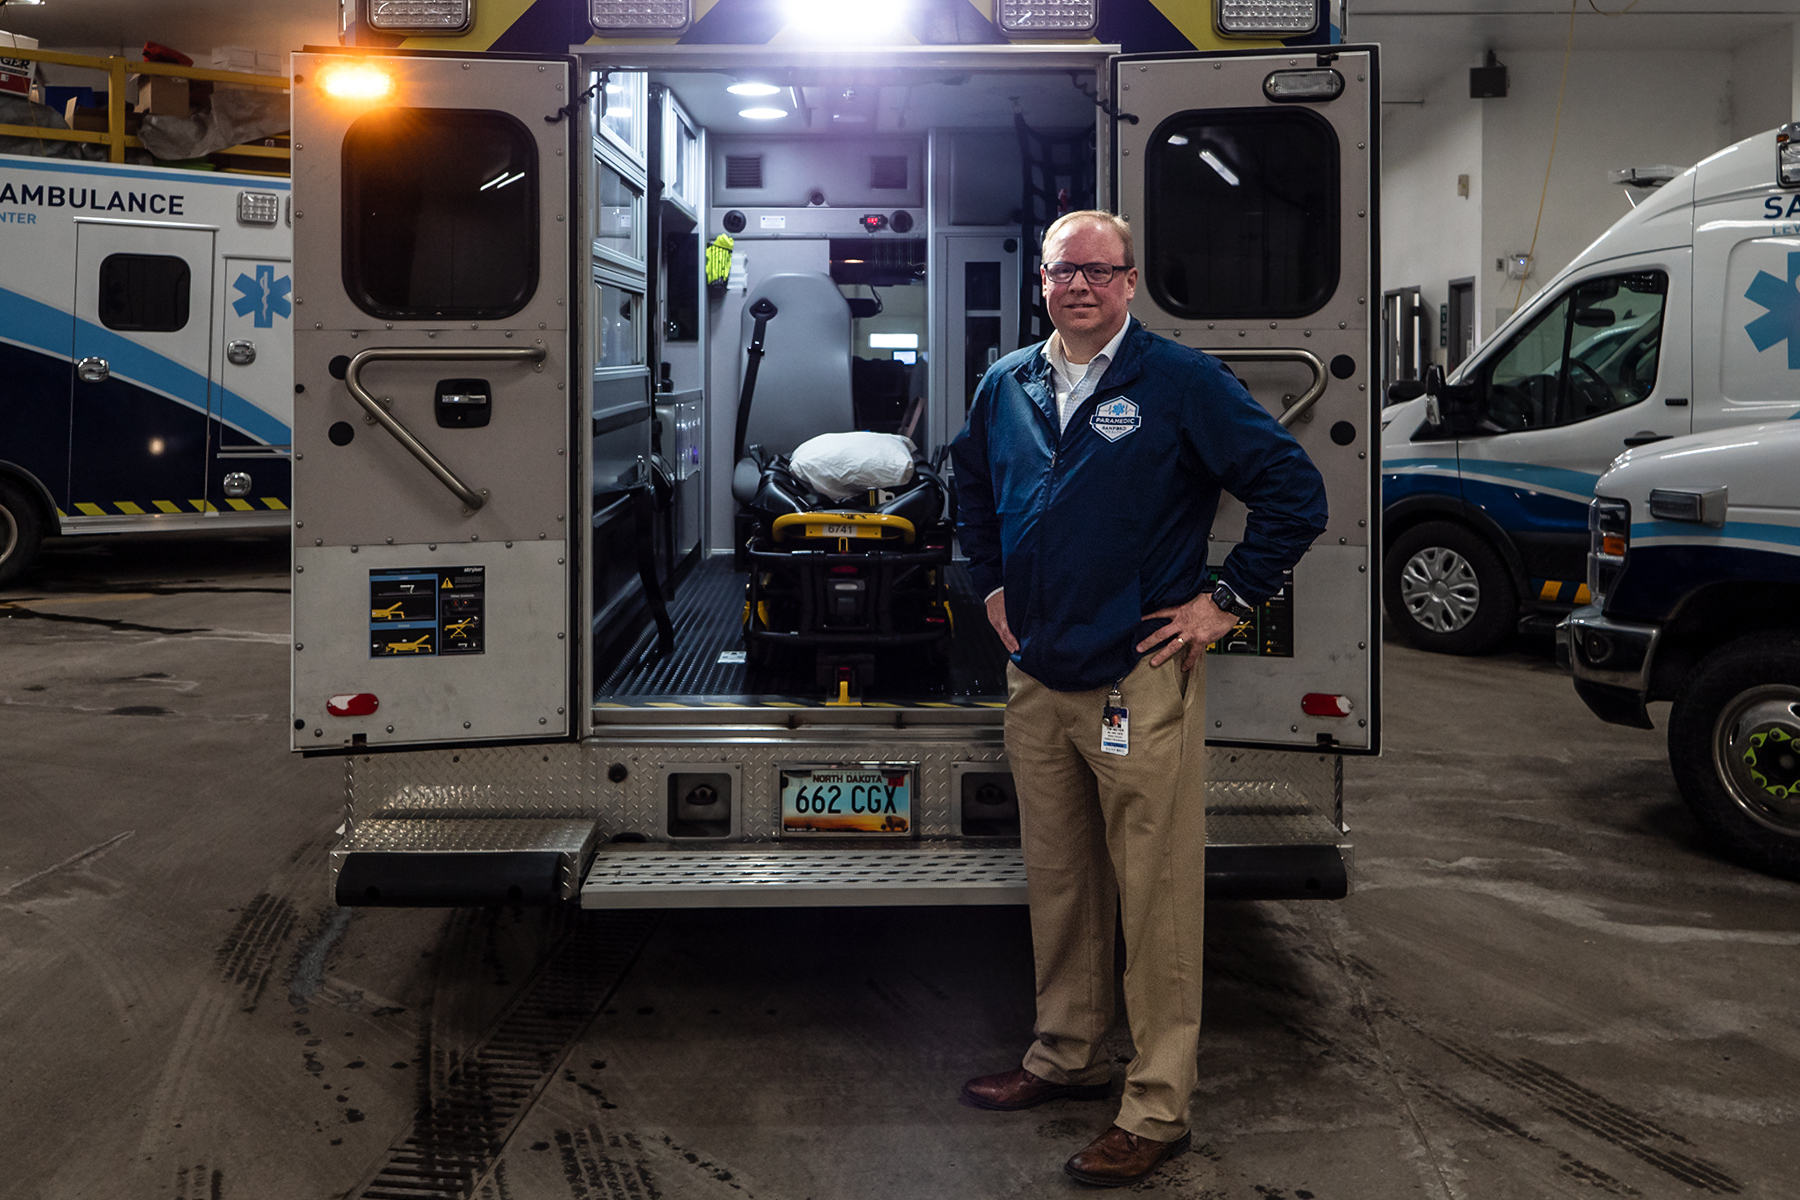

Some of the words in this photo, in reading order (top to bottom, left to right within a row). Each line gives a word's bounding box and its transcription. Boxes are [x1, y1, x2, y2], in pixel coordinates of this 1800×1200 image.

[0, 183, 184, 216] AMBULANCE
[1764, 194, 1800, 219] SA
[828, 524, 853, 534] 6741
[812, 774, 843, 783] NORTH
[846, 774, 883, 783] DAKOTA
[795, 785, 842, 814] 662
[851, 785, 898, 814] CGX
